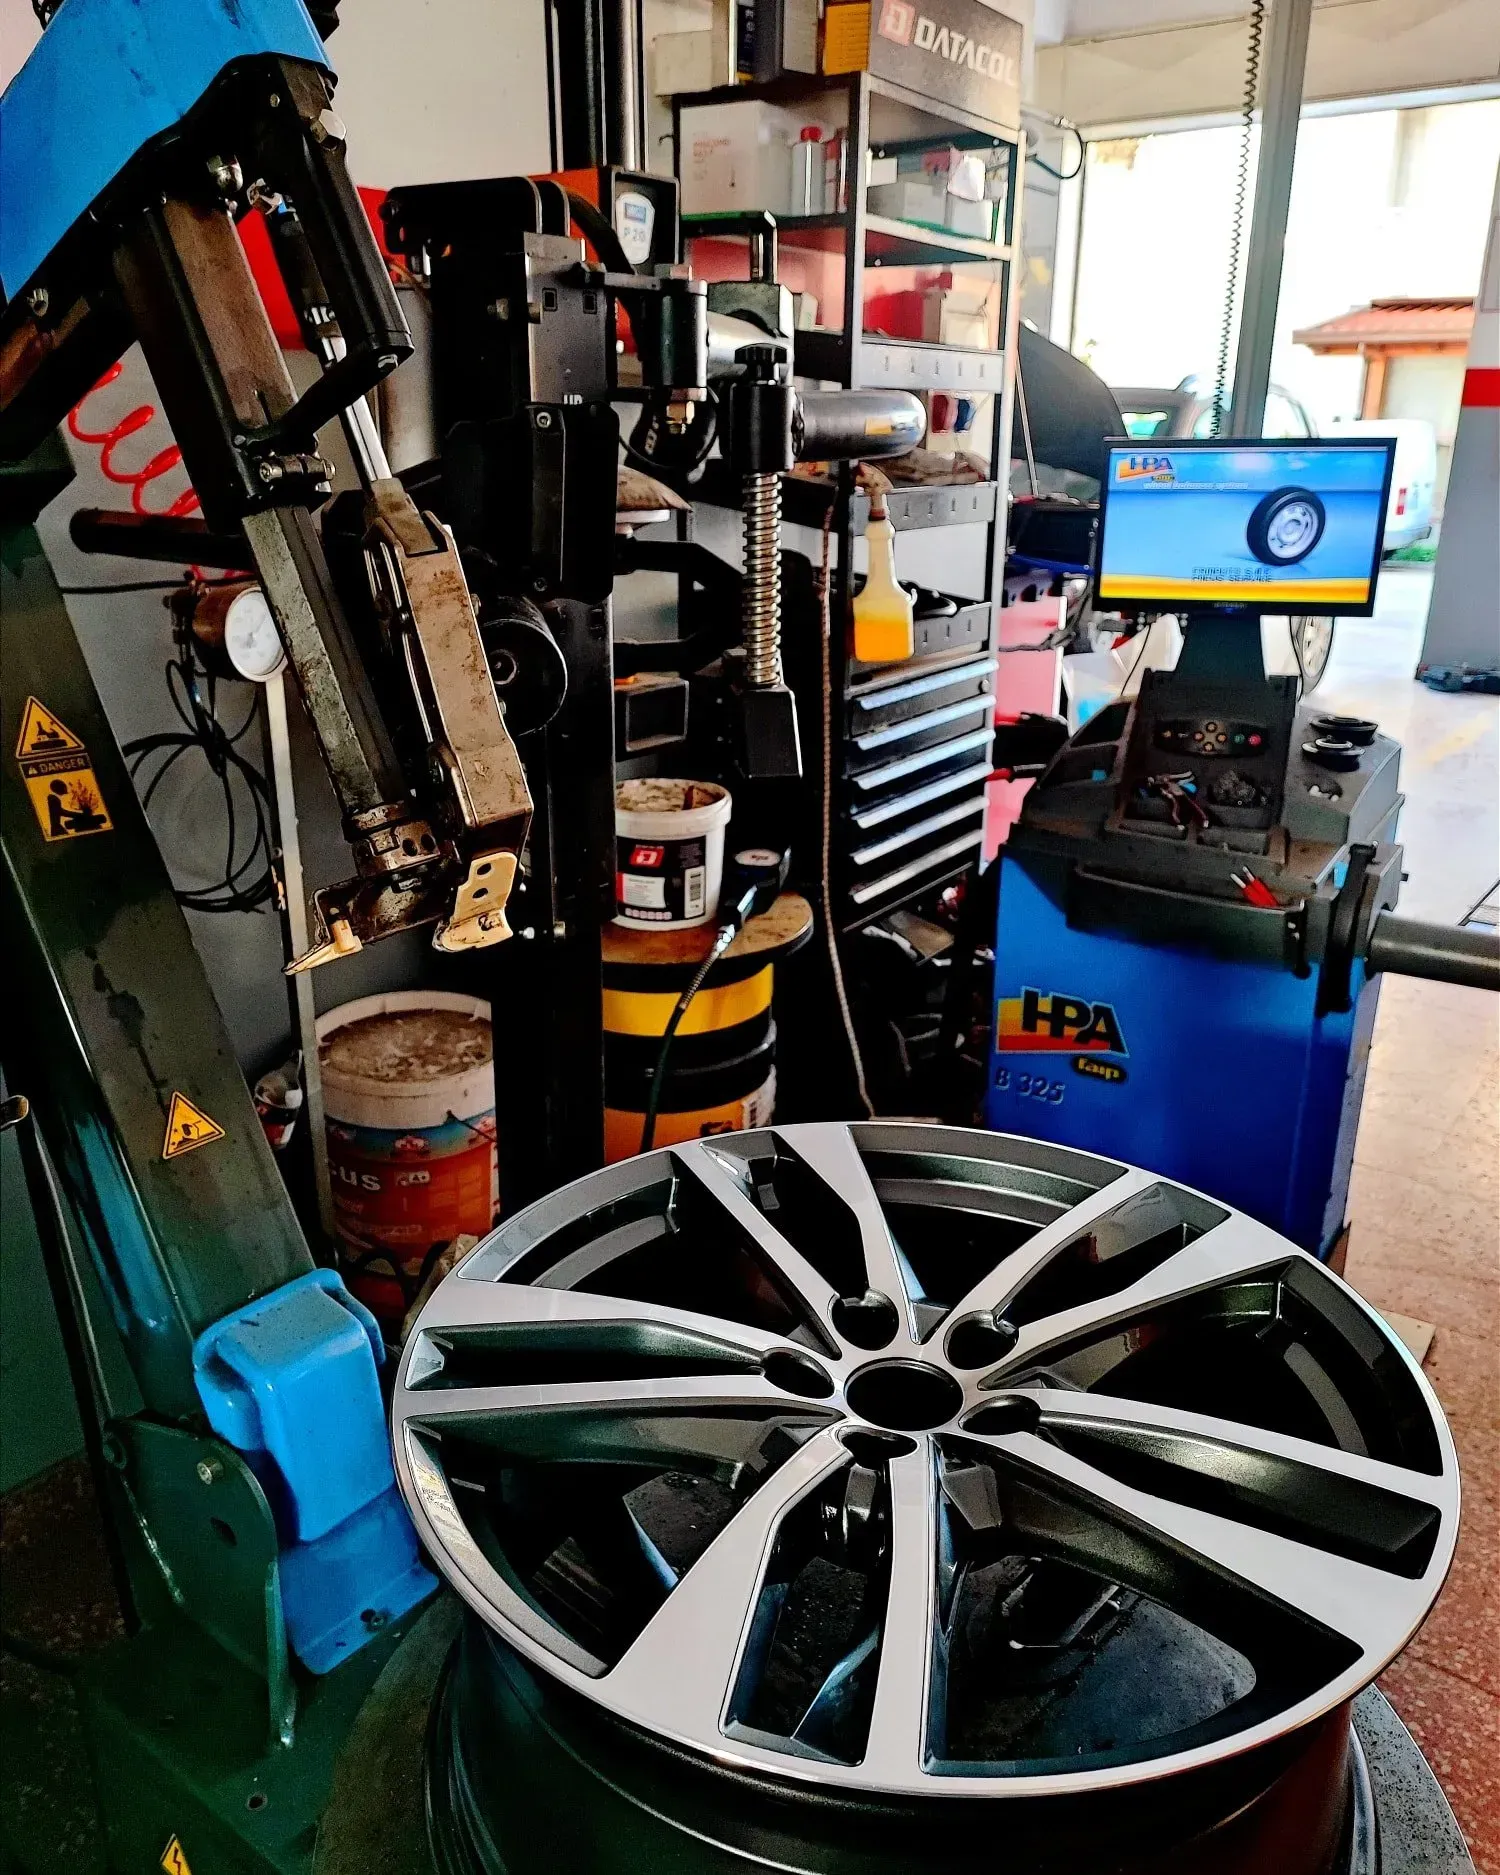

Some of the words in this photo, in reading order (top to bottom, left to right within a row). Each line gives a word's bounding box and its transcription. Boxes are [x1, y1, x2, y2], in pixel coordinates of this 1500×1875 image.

[914, 16, 1016, 87] DATACOL
[39, 758, 86, 773] DANGER
[1021, 987, 1129, 1056] HPA
